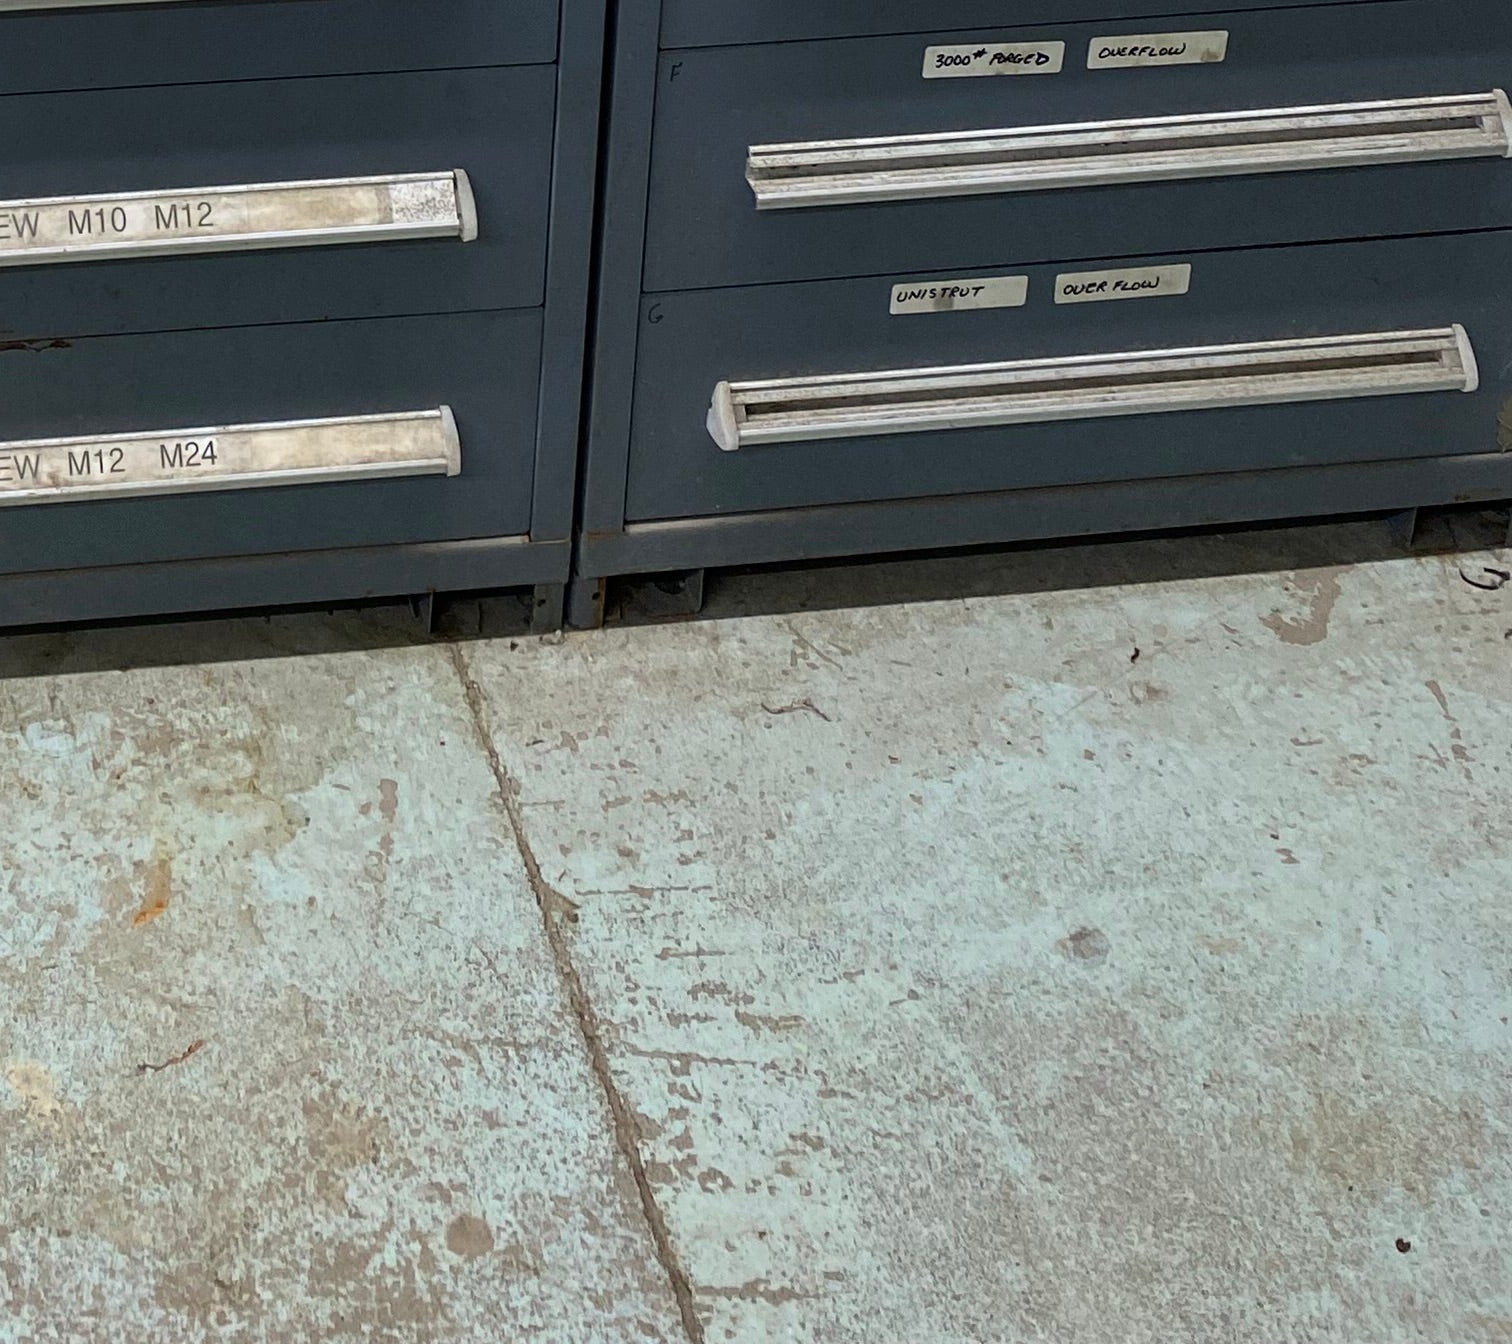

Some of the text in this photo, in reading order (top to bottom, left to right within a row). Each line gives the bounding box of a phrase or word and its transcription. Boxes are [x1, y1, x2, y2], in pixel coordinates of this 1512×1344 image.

[68, 205, 128, 235] M10
[154, 201, 215, 230] M12
[896, 285, 985, 303] UNISTRUT
[67, 446, 125, 475] M12
[159, 439, 218, 470] M24
